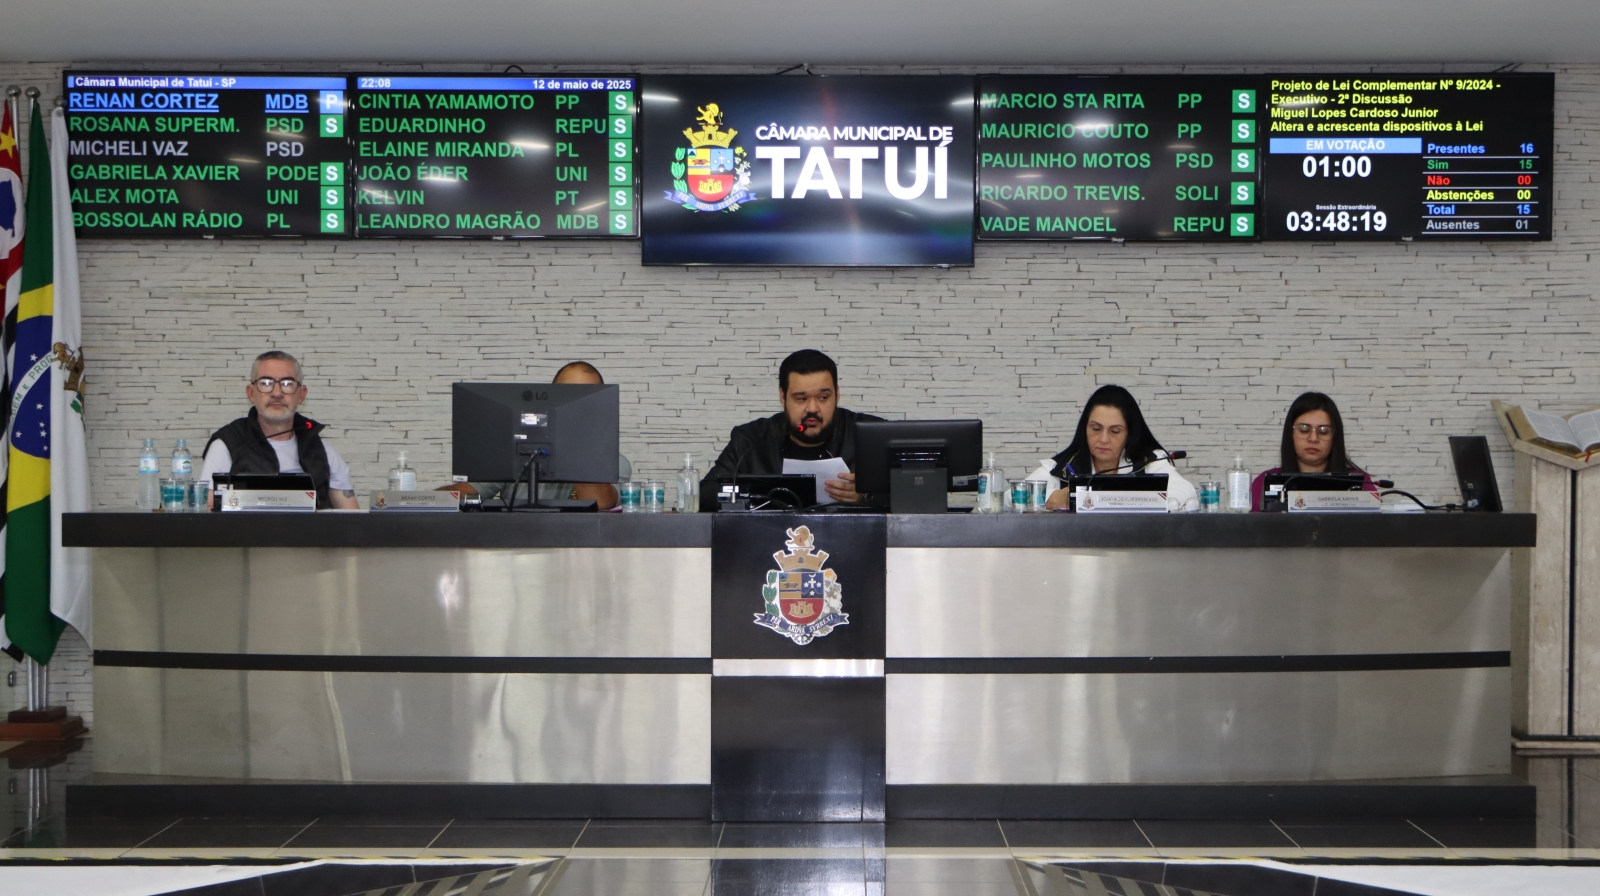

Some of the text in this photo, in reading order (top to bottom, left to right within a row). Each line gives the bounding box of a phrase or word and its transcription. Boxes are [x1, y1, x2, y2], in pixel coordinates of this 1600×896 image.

[76, 77, 115, 86] Câmara
[119, 77, 168, 88] Municipal
[171, 78, 184, 87] de
[222, 78, 236, 87] SP
[362, 78, 391, 87] 22:08
[533, 80, 631, 89] 12 de maio de 2025
[1272, 80, 1312, 92] Projeto
[1316, 81, 1330, 90] de
[1333, 81, 1350, 90] Lei
[1353, 80, 1437, 92] Complementar
[1456, 80, 1493, 90] 9/2024
[70, 93, 338, 110] RENAN CORTEZ MDB P
[359, 94, 627, 110] CINTIA YAMAMOTO PP S
[982, 93, 1250, 108] MARCIO STA RITA PP S
[1271, 93, 1328, 104] Executivo
[1352, 93, 1412, 104] Discussão
[1271, 107, 1438, 119] Miguel Lopes Cardoso Junior
[70, 117, 337, 133] ROSANA SUPERM. PSD S
[360, 118, 626, 134] EDUARDINHO REPU S
[755, 122, 953, 141] CÂMARA MUNICIPAL DE
[982, 123, 1249, 138] MAURICIO COUTO PP S
[1271, 122, 1304, 131] Altera
[1317, 122, 1380, 131] acrescenta
[1383, 121, 1453, 132] dispositivos
[1456, 122, 1462, 131] à
[1466, 121, 1483, 130] Lei
[71, 141, 304, 156] MICHELI VAZ PSD
[360, 142, 626, 157] ELAINE MIRANDA PL S
[1307, 138, 1385, 152] EM VOTAÇÃO
[1428, 143, 1534, 153] Presentes 16
[982, 153, 1249, 168] PAULINHO MOTOS PSD S
[1303, 156, 1371, 177] 01:00
[1428, 159, 1532, 169] Sim 15
[70, 164, 338, 181] GABRIELA XAVIER PODE S
[359, 162, 626, 181] JOÃO ÉDER UNI S
[756, 141, 951, 200] TATUÍ
[1428, 175, 1531, 185] Não 00
[71, 188, 338, 205] ALEX MOTA UNI S
[358, 190, 626, 206] KELVIN PT S
[981, 185, 1248, 200] RICARDO TREVIS. SOLI S
[1427, 190, 1531, 201] Abstenções 00
[1427, 204, 1530, 214] Total 15
[72, 211, 338, 228] BOSSOLAN RÁDIO PL S
[359, 212, 626, 229] LEANDRO MAGRÃO MDB S
[981, 217, 1248, 232] VADE MANOEL REPU S
[1287, 211, 1386, 231] 03:48:19
[1426, 220, 1528, 229] Ausentes 01
[535, 392, 549, 400] LG
